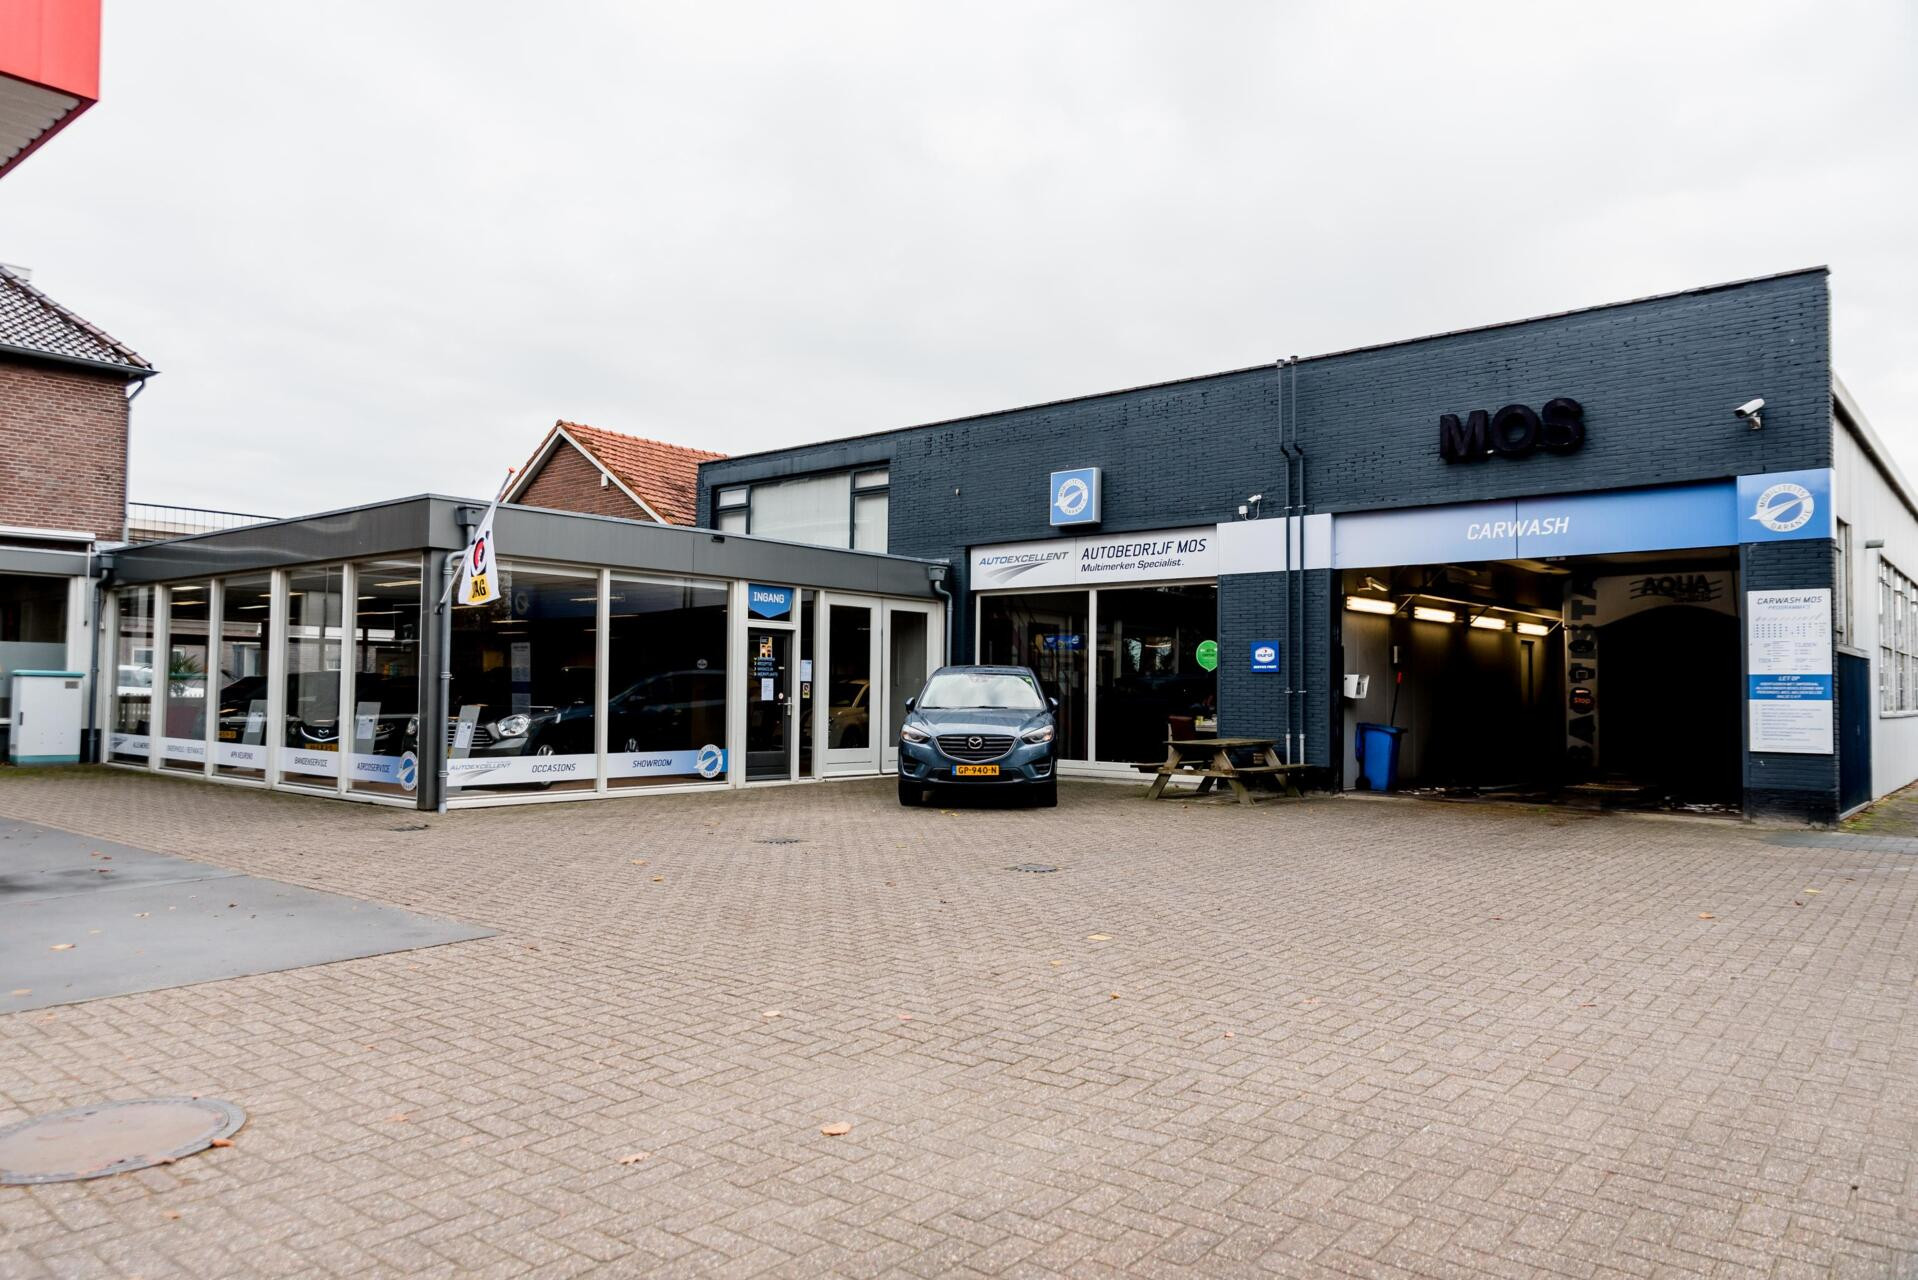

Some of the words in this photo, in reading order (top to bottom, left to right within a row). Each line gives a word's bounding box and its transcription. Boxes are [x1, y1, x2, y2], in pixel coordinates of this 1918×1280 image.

[1439, 397, 1585, 464] MOS
[1759, 484, 1806, 508] MOBILITEITS
[1466, 516, 1570, 540] CARWASH
[1081, 540, 1175, 560] AUTOBEDRIJF
[1176, 538, 1207, 554] MOS
[979, 551, 1069, 566] AUTOEXCELLENT
[1080, 562, 1136, 573] Multimerken
[1136, 558, 1184, 570] Specialist.
[1641, 574, 1712, 595] AQUA
[753, 591, 785, 603] INGANG
[1757, 596, 1801, 605] CARWASH
[1803, 595, 1823, 603] MOS
[294, 756, 328, 768] BANDENSERVICE
[357, 762, 392, 773] AIRCOSERVICE
[450, 762, 512, 771] AUTOEXCELLENT
[531, 763, 577, 773] OCCASIONS
[632, 758, 673, 768] SHOWROOM
[958, 766, 997, 774] GP-940-N
